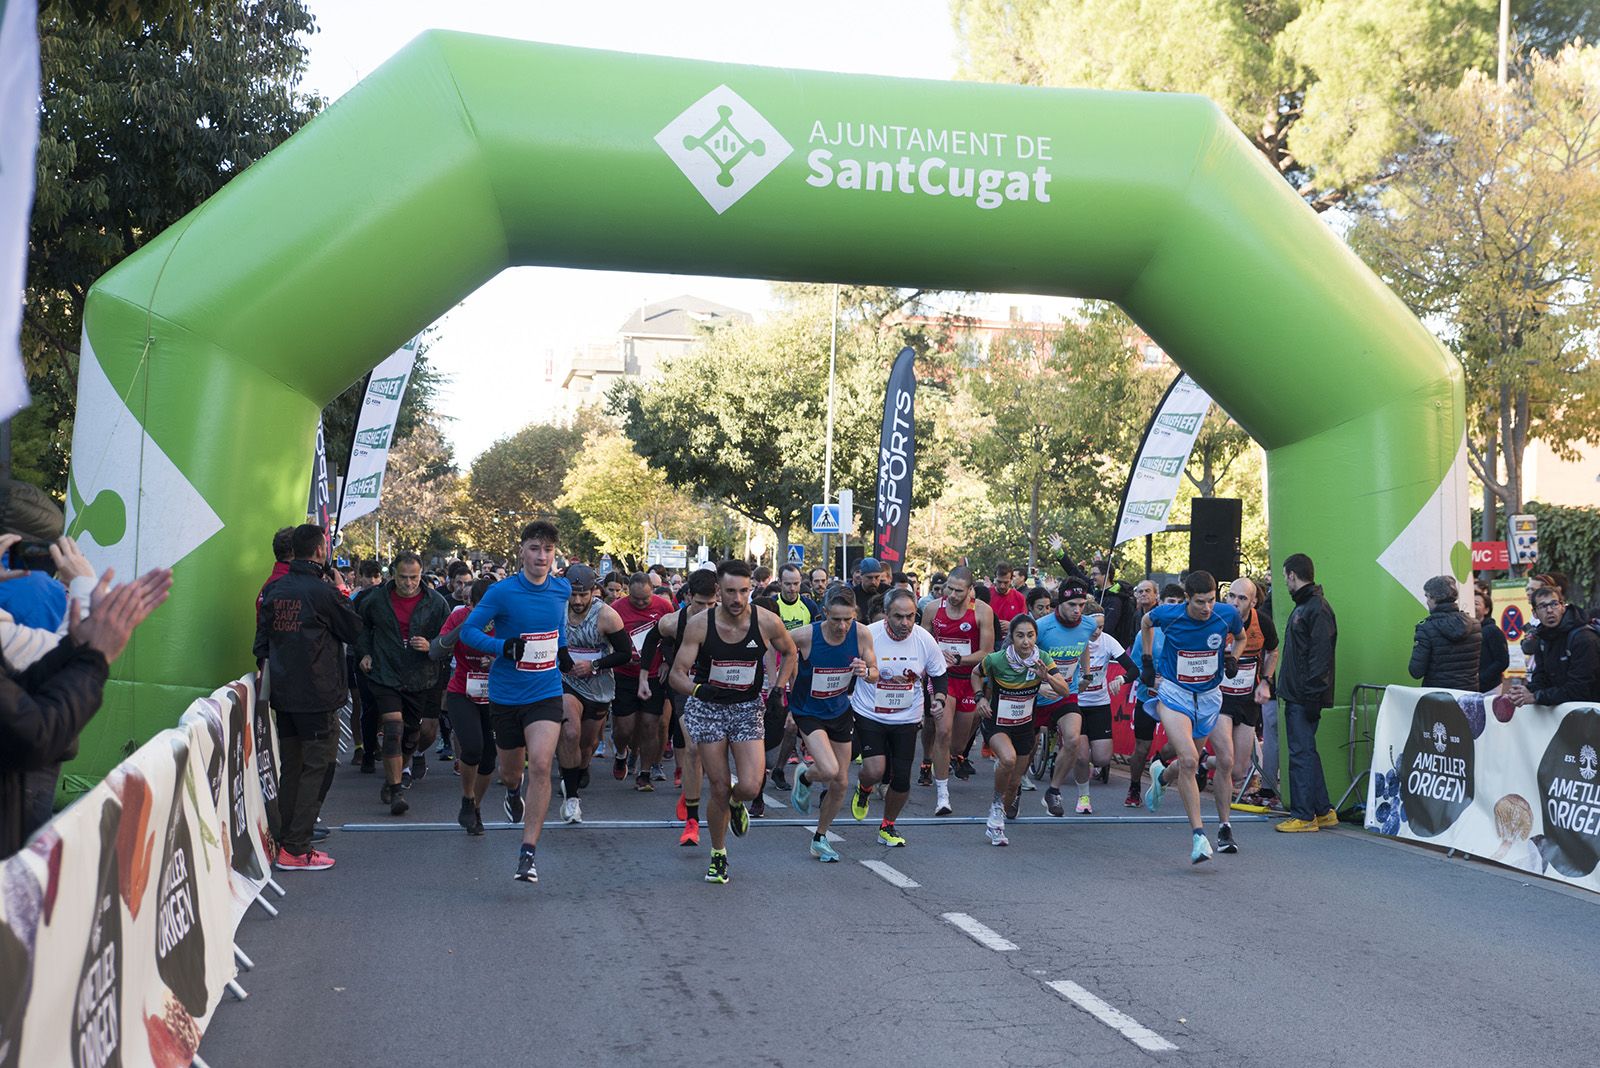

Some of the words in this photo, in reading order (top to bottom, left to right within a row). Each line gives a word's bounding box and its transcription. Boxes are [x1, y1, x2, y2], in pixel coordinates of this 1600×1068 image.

[808, 120, 1007, 157] AJUNTAMENT
[1016, 135, 1053, 160] DE
[805, 148, 1052, 209] SantCugat
[886, 388, 912, 527] SPORTS
[1472, 549, 1492, 562] WC
[602, 561, 610, 571] P
[273, 599, 302, 610] MITJA
[275, 610, 300, 621] SANT
[273, 620, 303, 632] CUGAT
[725, 674, 740, 682] 3189
[1413, 752, 1466, 777] AMETLLER
[1564, 754, 1576, 763] EST.
[1408, 770, 1466, 804] ORIGEN
